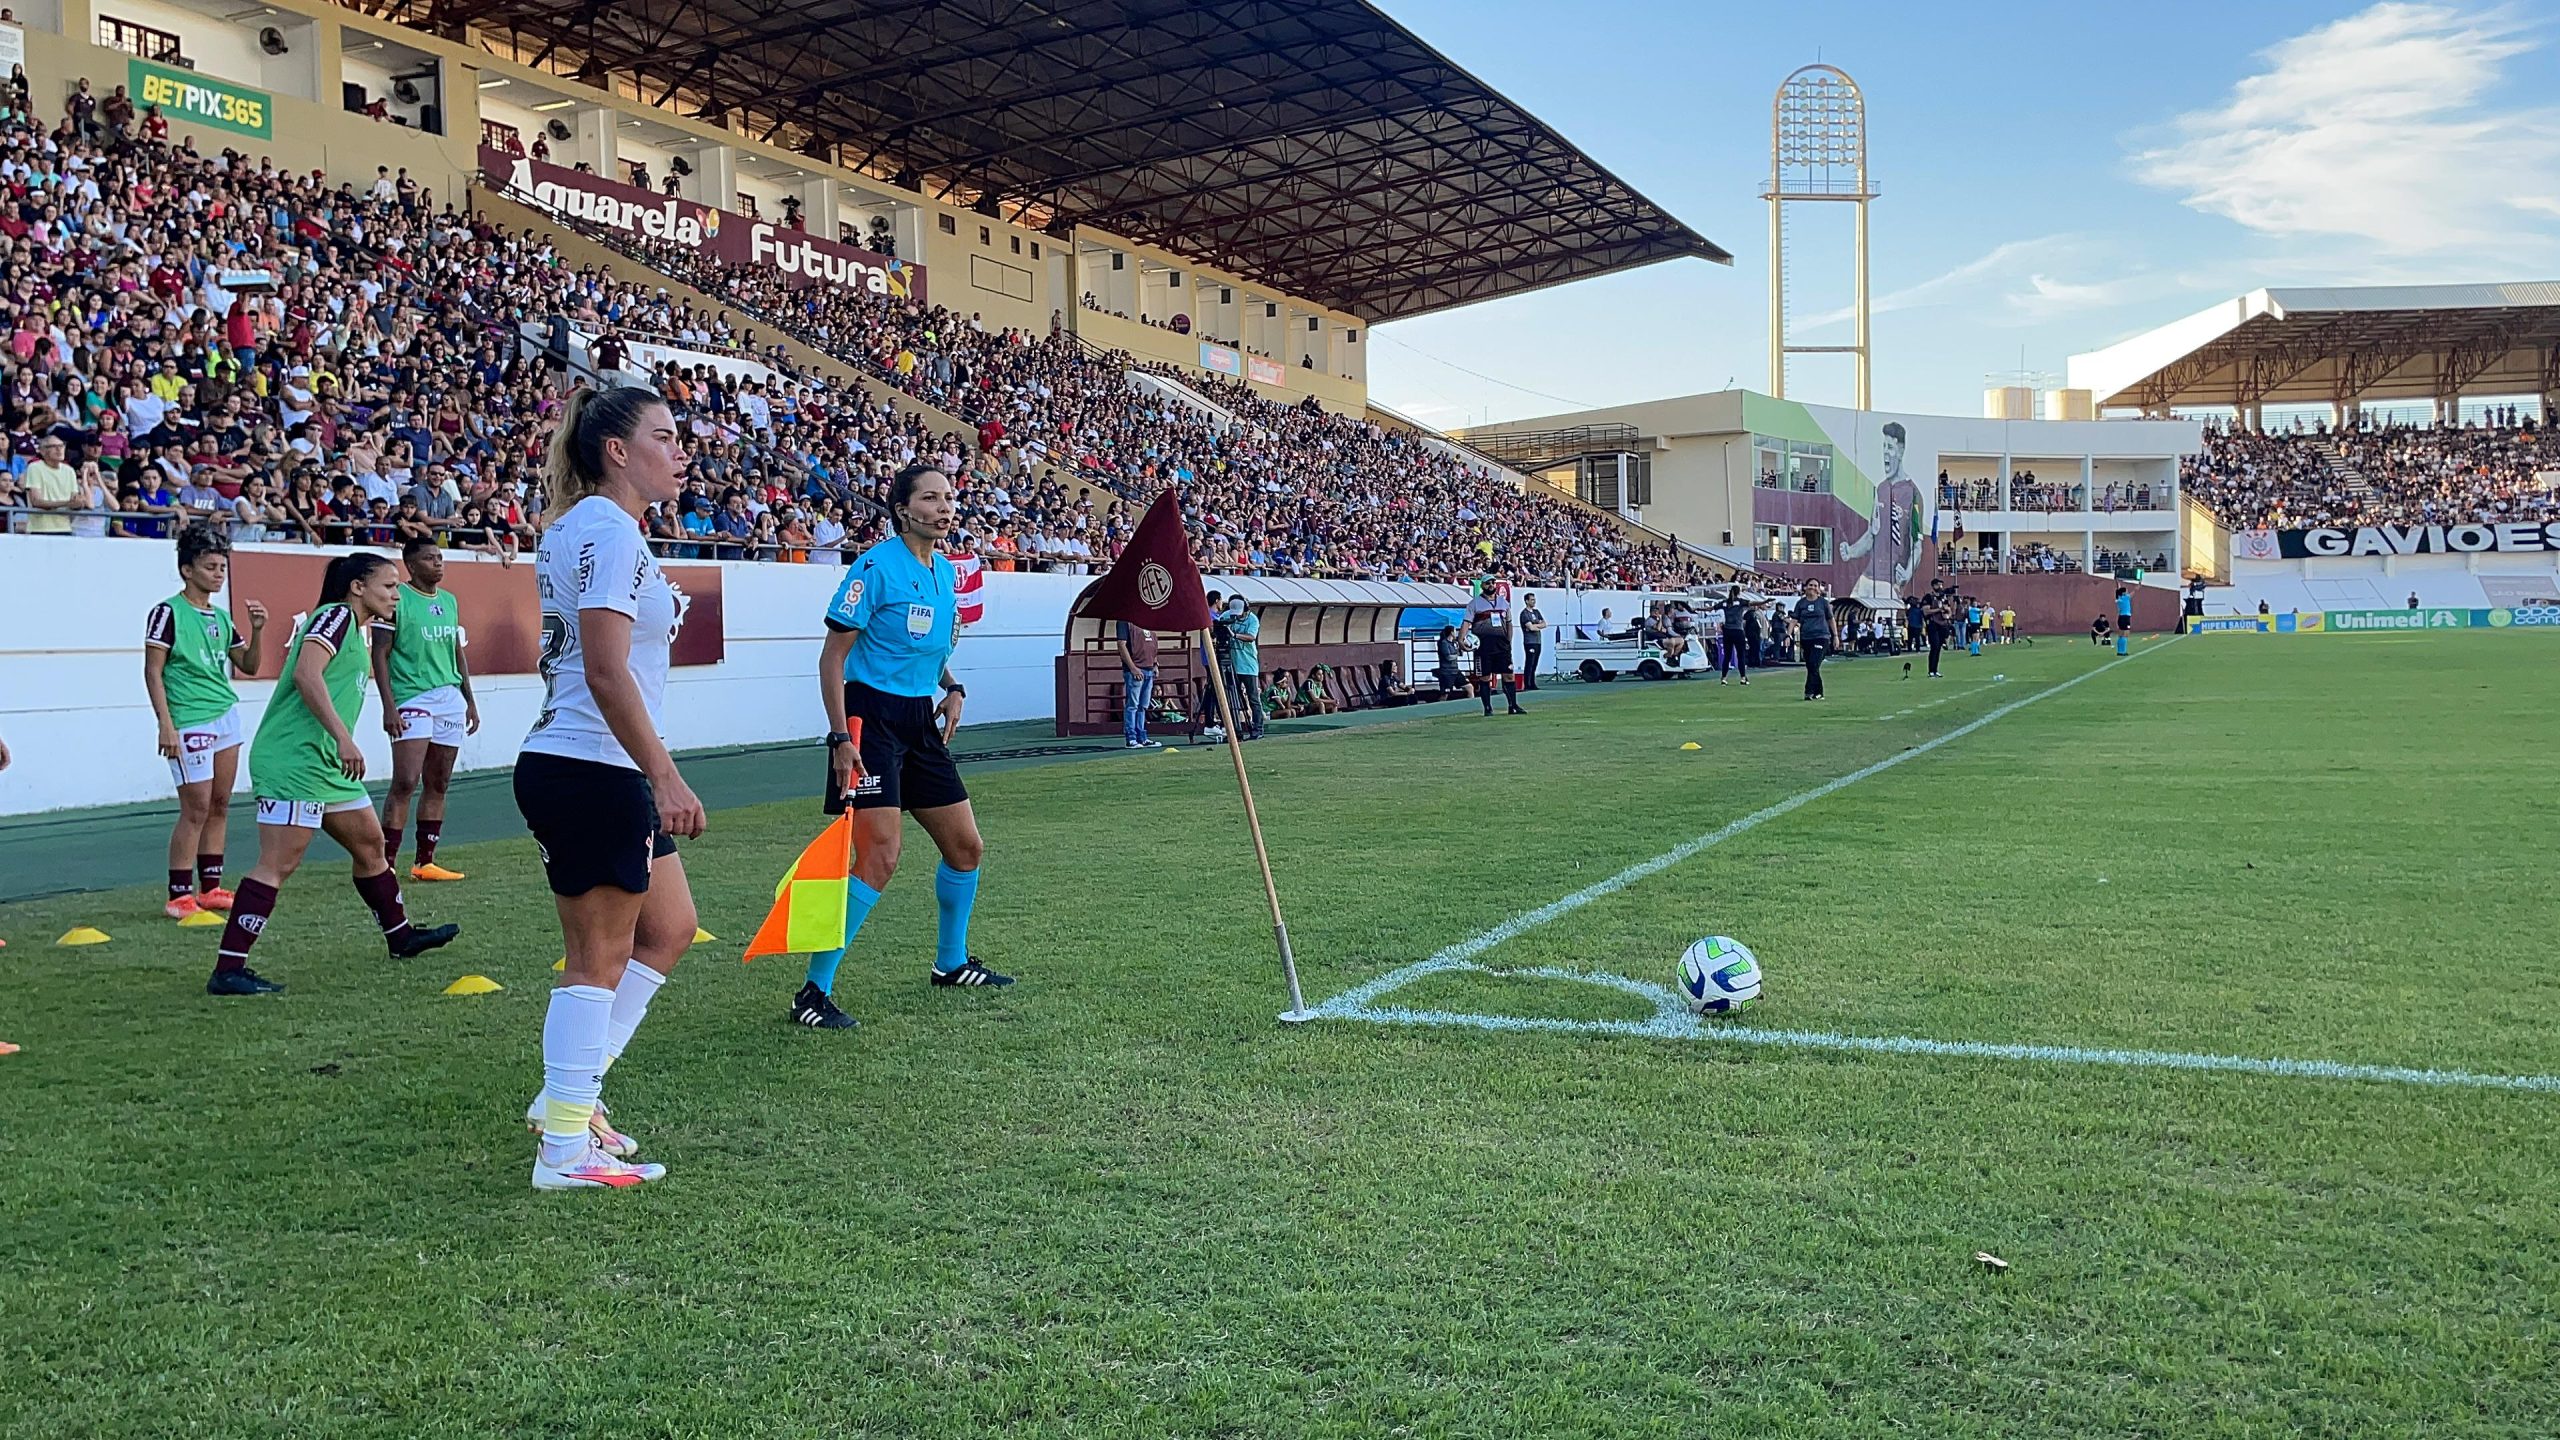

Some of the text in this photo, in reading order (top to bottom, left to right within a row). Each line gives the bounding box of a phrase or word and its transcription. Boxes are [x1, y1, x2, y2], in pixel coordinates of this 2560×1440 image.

[143, 75, 263, 128] BETPIX365
[497, 158, 702, 247] Aquarela
[750, 223, 888, 296] Futura
[839, 580, 864, 617] DGO
[911, 606, 931, 617] FIFA
[2201, 618, 2257, 630] HIPER SAÚDE
[2335, 611, 2424, 629] Unimed
[857, 776, 881, 787] CBF
